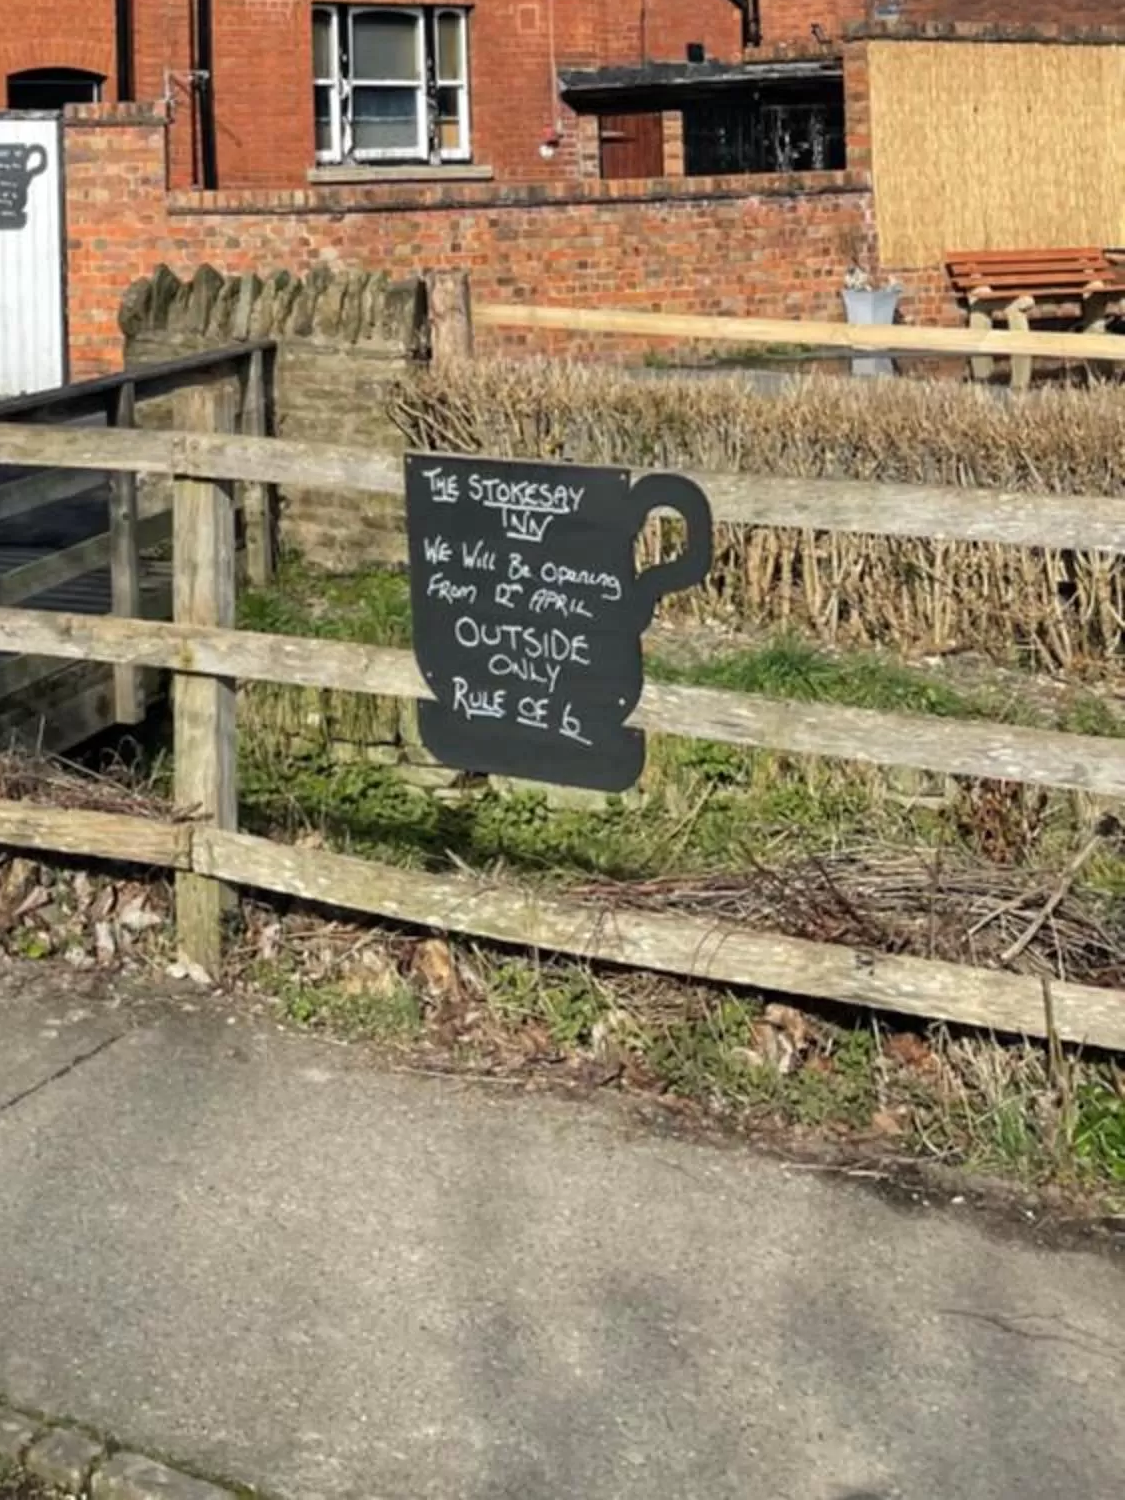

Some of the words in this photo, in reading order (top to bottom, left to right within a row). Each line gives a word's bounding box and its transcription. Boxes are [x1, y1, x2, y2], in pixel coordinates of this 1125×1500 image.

[422, 466, 460, 498] THE
[468, 473, 586, 512] STOKESAY
[500, 506, 554, 539] INN
[528, 587, 594, 618] APRIL
[454, 615, 591, 666] OUTSIDE
[488, 653, 561, 693] ONLY
[451, 675, 507, 720] RULE
[517, 696, 550, 722] OF
